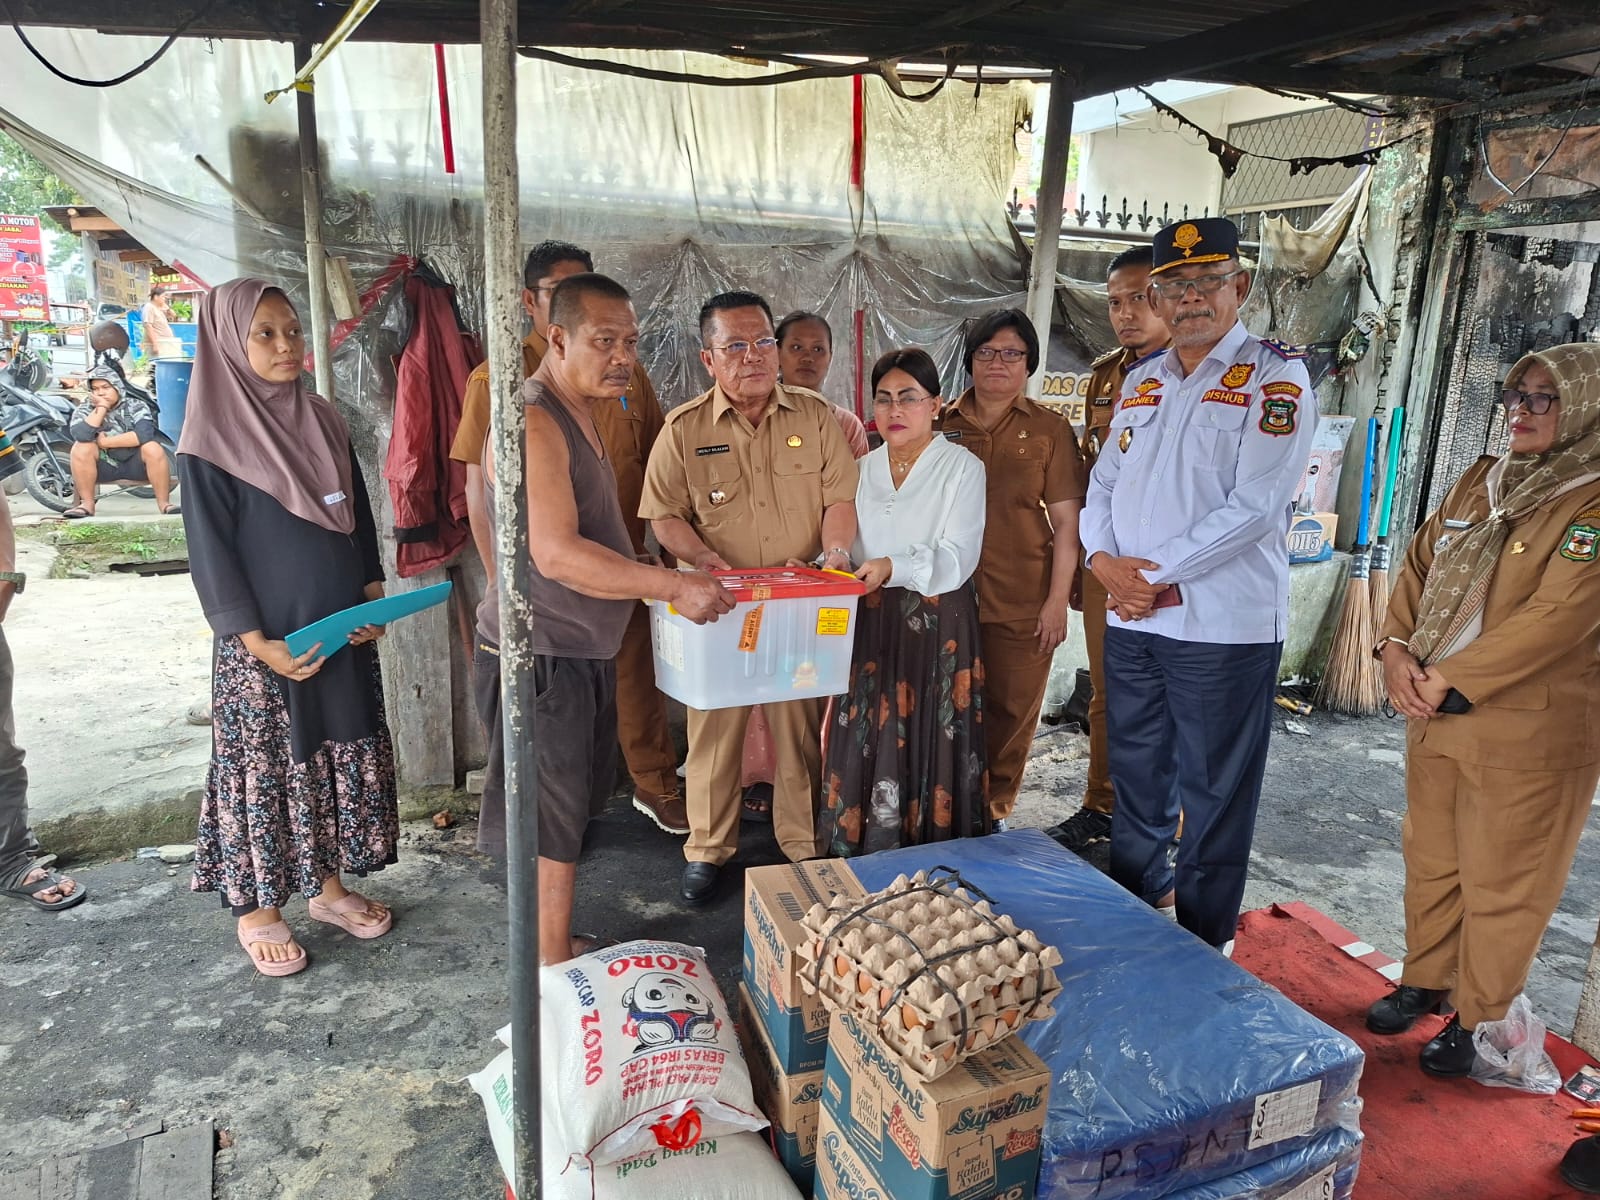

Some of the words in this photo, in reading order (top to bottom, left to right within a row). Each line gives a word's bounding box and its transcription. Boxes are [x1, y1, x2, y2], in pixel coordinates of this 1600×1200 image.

[8, 218, 35, 226] MOTOR
[1123, 397, 1155, 407] DANIEL
[1204, 391, 1245, 404] DISHUB
[608, 954, 699, 978] ZORO
[577, 984, 596, 1008] CAP
[581, 1009, 604, 1086] ZORO
[684, 1049, 725, 1065] BERAS
[620, 1058, 649, 1078] CAP
[840, 1013, 927, 1122] Supermi
[945, 1083, 1048, 1136] Supermi
[616, 1153, 657, 1179] Padi
[848, 1157, 868, 1187] instan
[956, 1160, 989, 1181] Kaldu
[959, 1168, 991, 1189] Ayam
